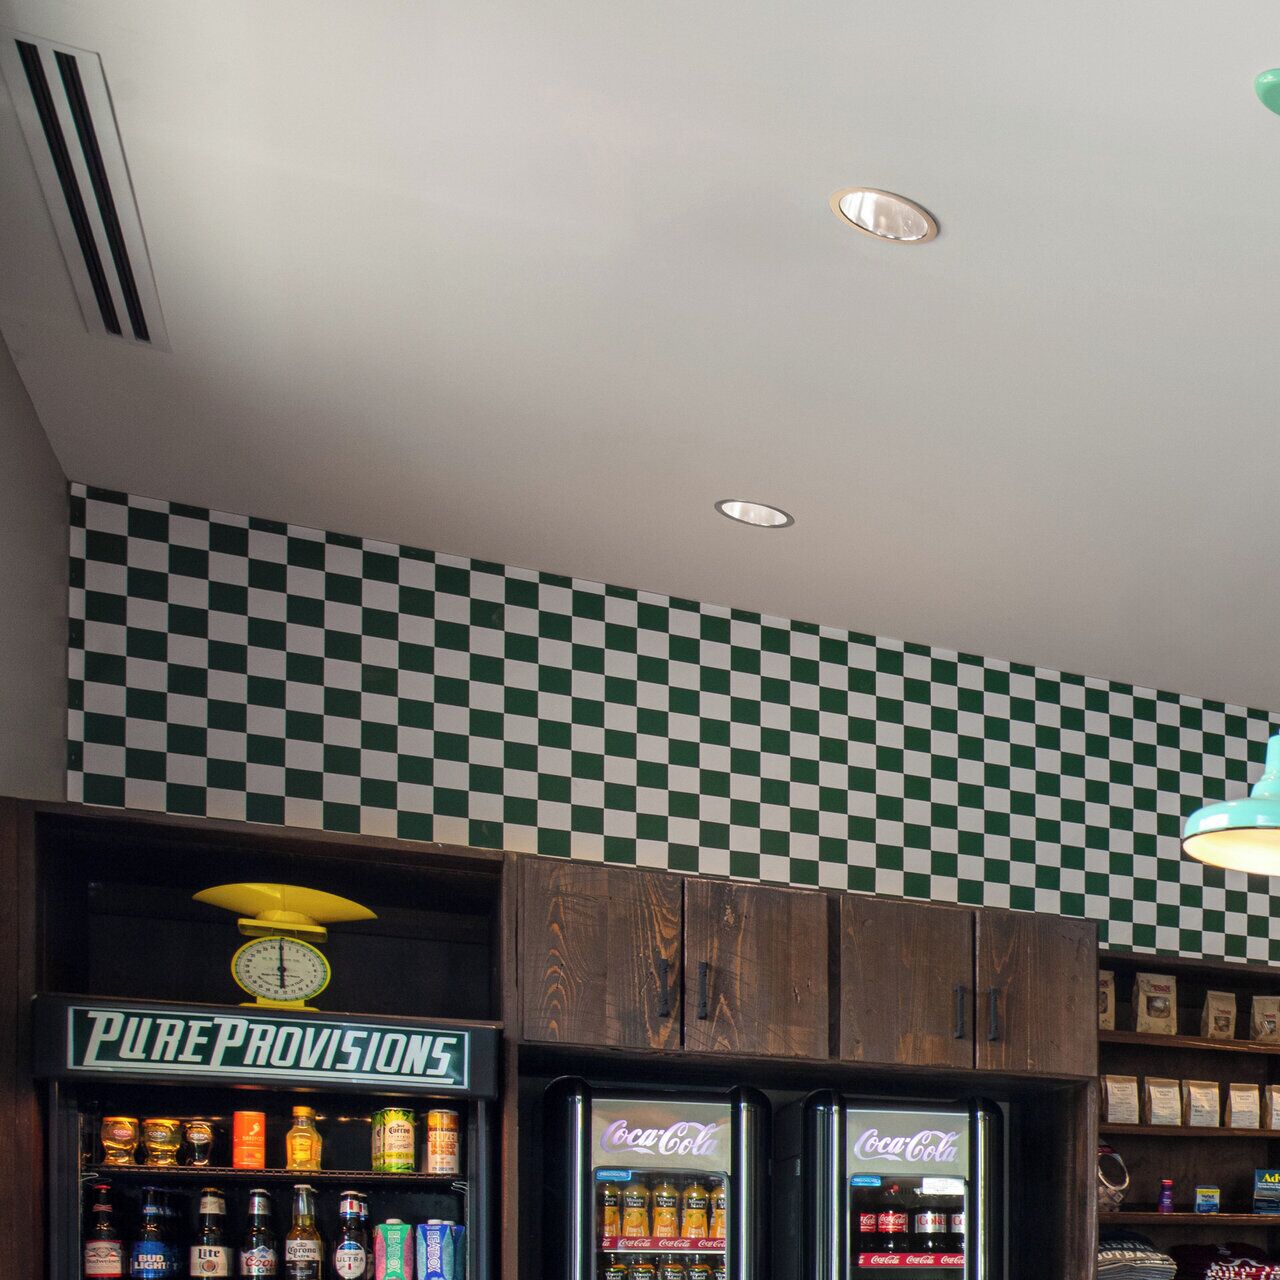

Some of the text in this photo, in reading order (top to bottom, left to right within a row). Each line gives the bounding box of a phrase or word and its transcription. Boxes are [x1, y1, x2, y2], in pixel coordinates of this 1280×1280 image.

[600, 1119, 721, 1156] Coca-Cola
[854, 1128, 962, 1162] Coca-Cola
[878, 1213, 906, 1225] Coca-Cola
[658, 1239, 692, 1248] Coca-Cola
[198, 1248, 221, 1259] Lite
[287, 1245, 318, 1255] Corona
[387, 1230, 401, 1273] BEATBOX
[427, 1230, 441, 1273] BEATBOX
[86, 1257, 121, 1265] Budweiser
[138, 1254, 164, 1263] BUD
[336, 1256, 365, 1264] ULTRA
[870, 1254, 936, 1265] Coca-Cola Coca-Cola
[134, 1261, 167, 1270] LIGHT
